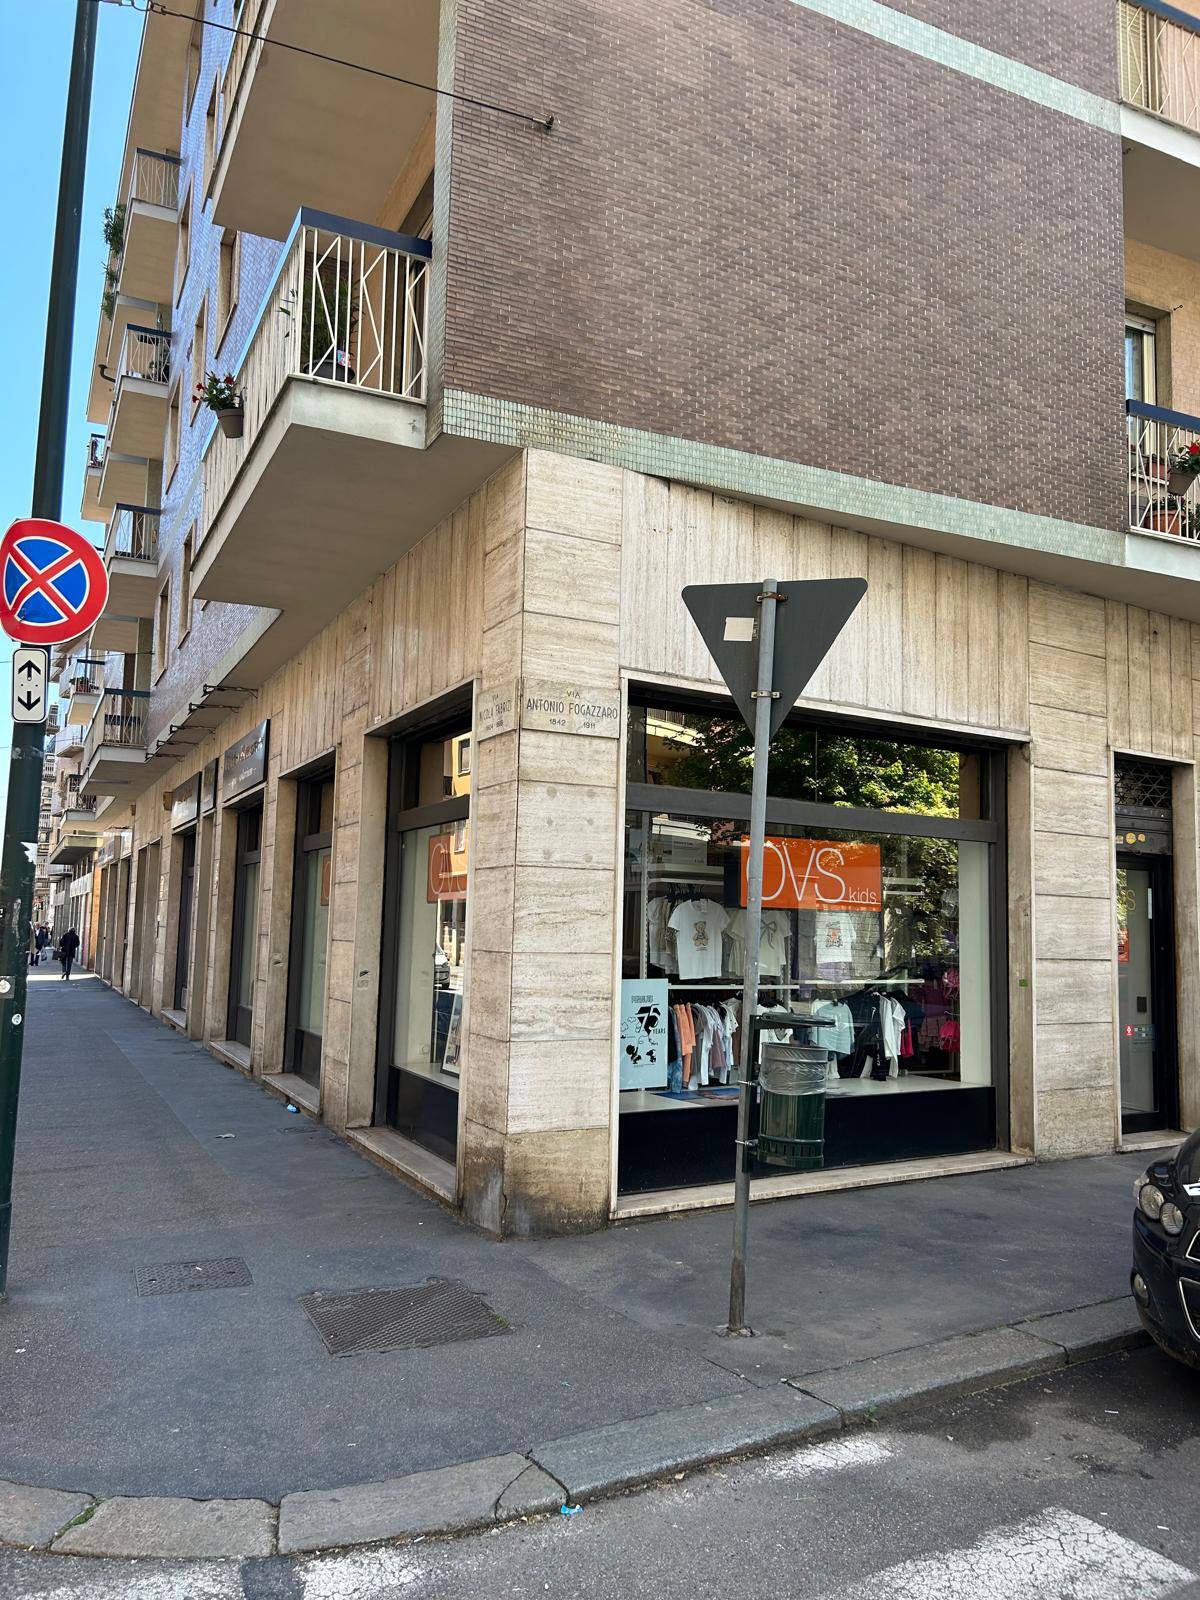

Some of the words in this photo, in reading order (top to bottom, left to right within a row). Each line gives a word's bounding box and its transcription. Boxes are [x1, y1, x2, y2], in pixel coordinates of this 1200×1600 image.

[526, 698, 565, 714] ANTONIO
[568, 702, 618, 720] FOGAZZARO
[549, 718, 566, 727] 1842
[583, 721, 596, 729] 1911
[746, 842, 846, 903] OVS
[848, 887, 878, 904] kids
[652, 1027, 666, 1035] YEARS
